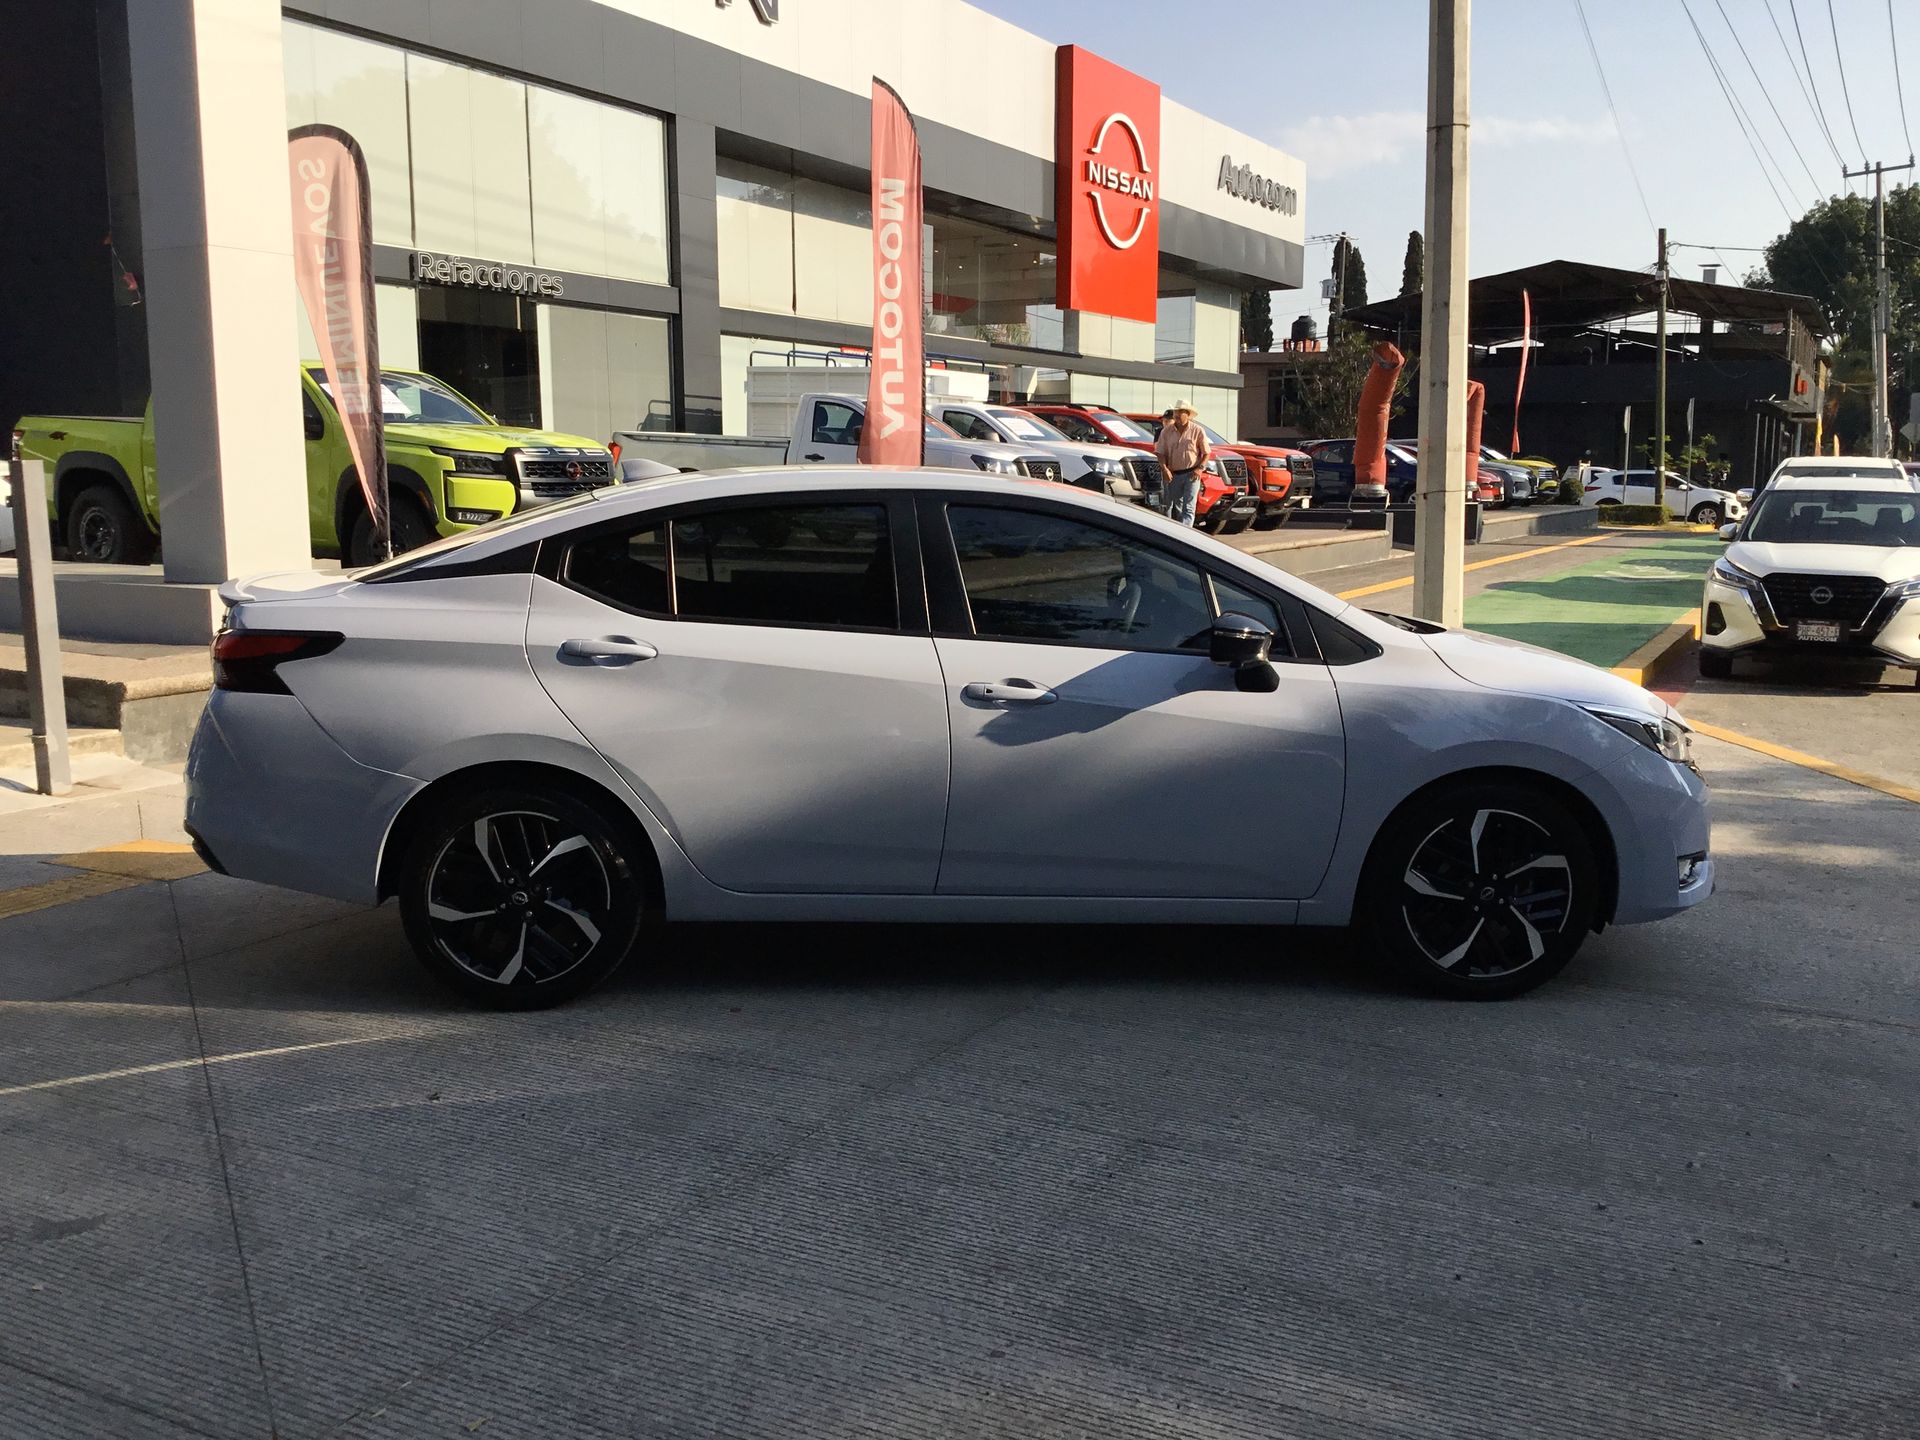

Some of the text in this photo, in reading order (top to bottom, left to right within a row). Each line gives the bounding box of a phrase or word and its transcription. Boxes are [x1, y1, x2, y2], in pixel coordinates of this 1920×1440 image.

[1088, 160, 1153, 201] NISSAN
[1217, 154, 1297, 217] Autocom
[417, 251, 564, 296] Refacciones
